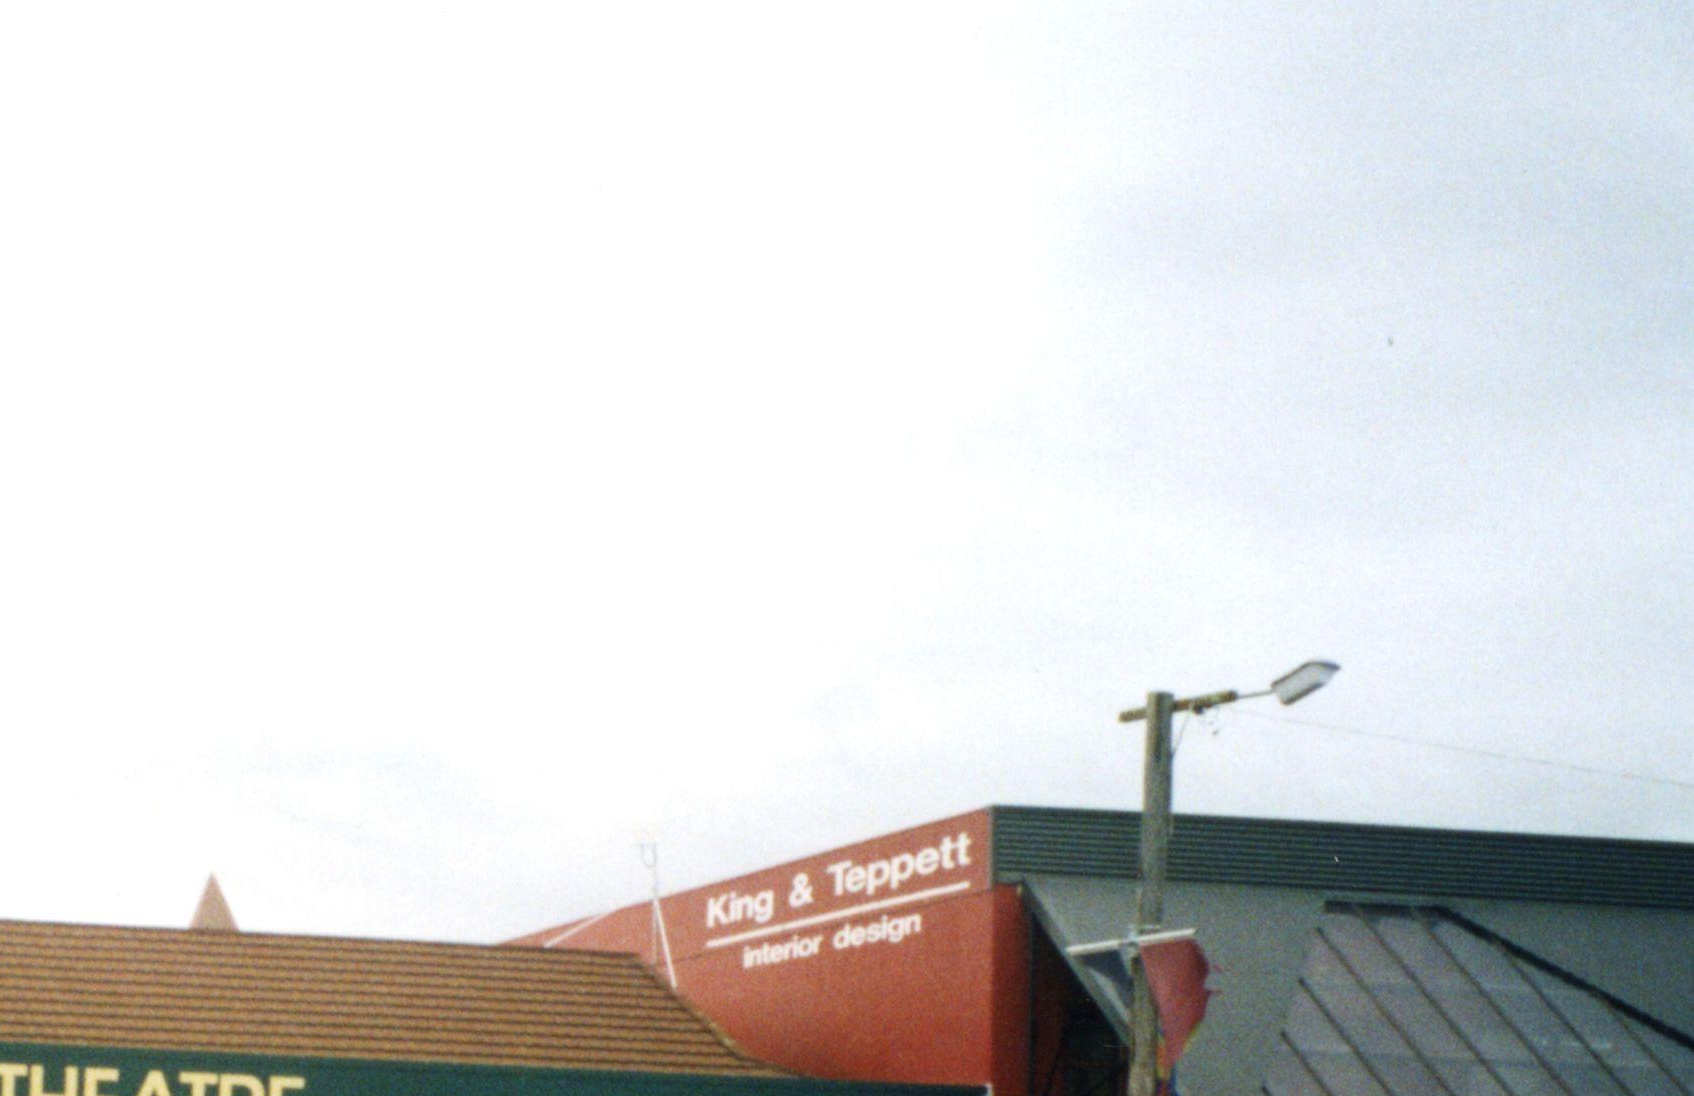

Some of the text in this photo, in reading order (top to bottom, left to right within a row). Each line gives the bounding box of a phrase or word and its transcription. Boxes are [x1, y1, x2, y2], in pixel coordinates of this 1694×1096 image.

[705, 831, 972, 928] King & Teppett
[742, 913, 923, 969] interior design
